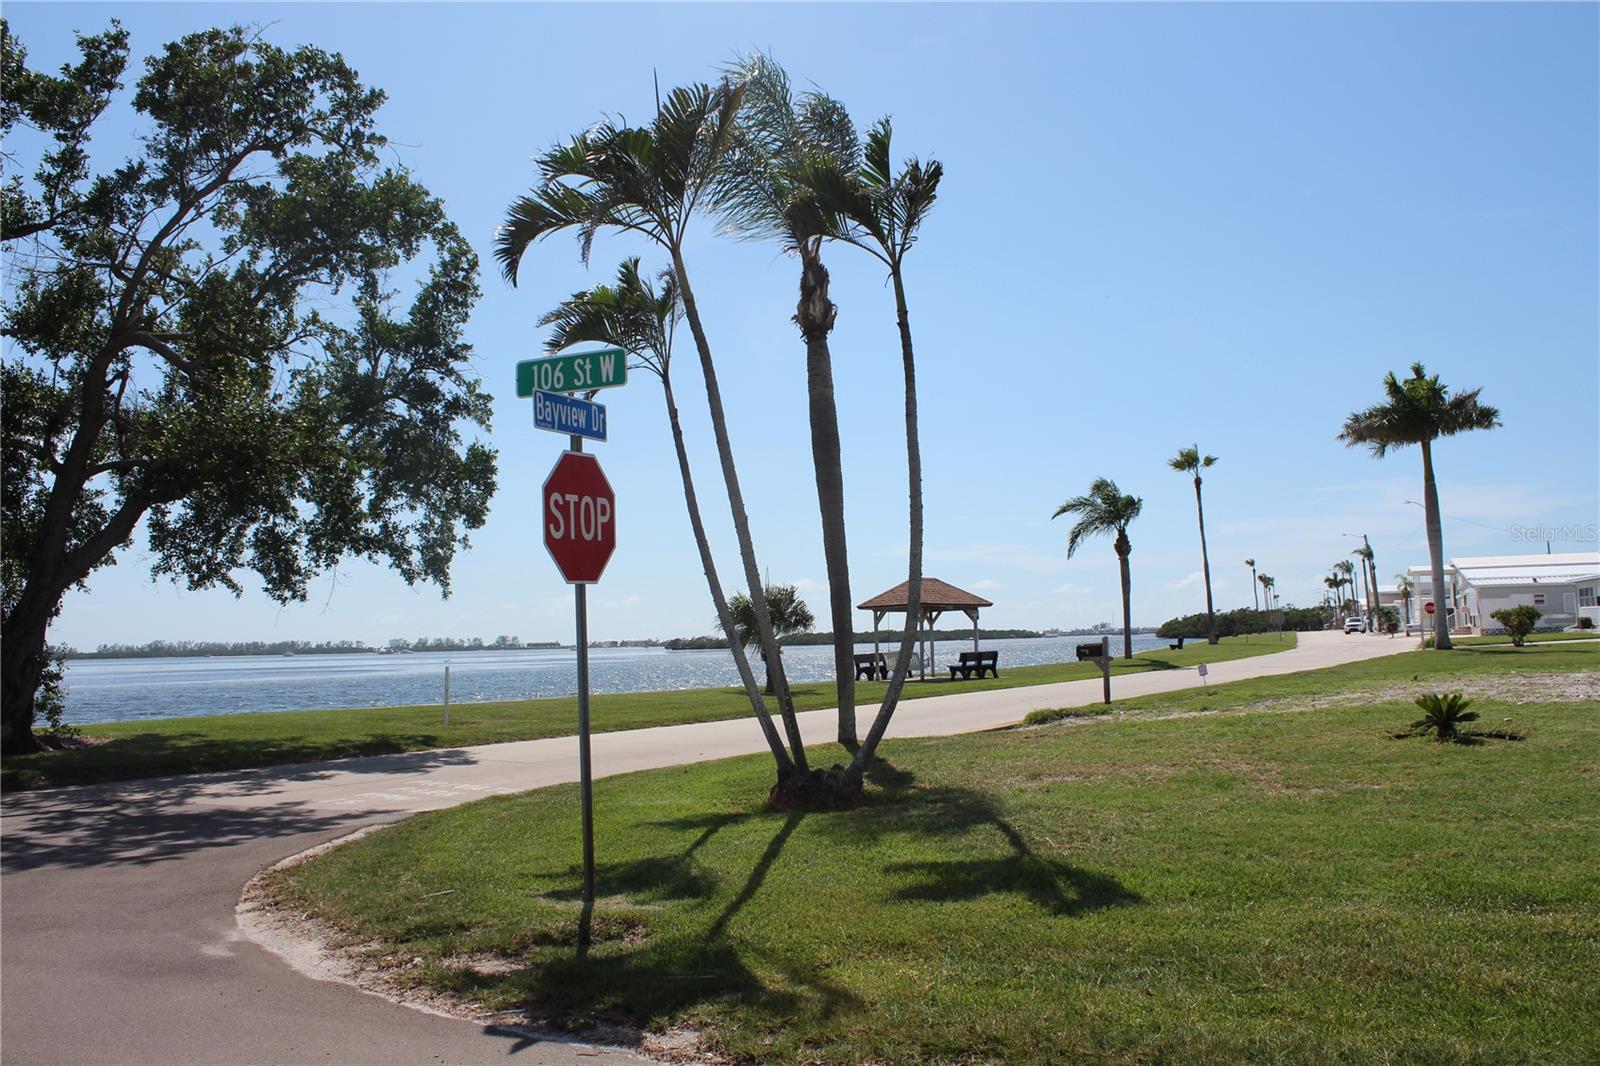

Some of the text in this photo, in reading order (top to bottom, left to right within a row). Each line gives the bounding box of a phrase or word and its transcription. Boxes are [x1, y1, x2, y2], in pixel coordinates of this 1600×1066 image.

[532, 354, 615, 390] 106 St W
[536, 391, 604, 433] Bayview Dr
[549, 492, 611, 542] STOP
